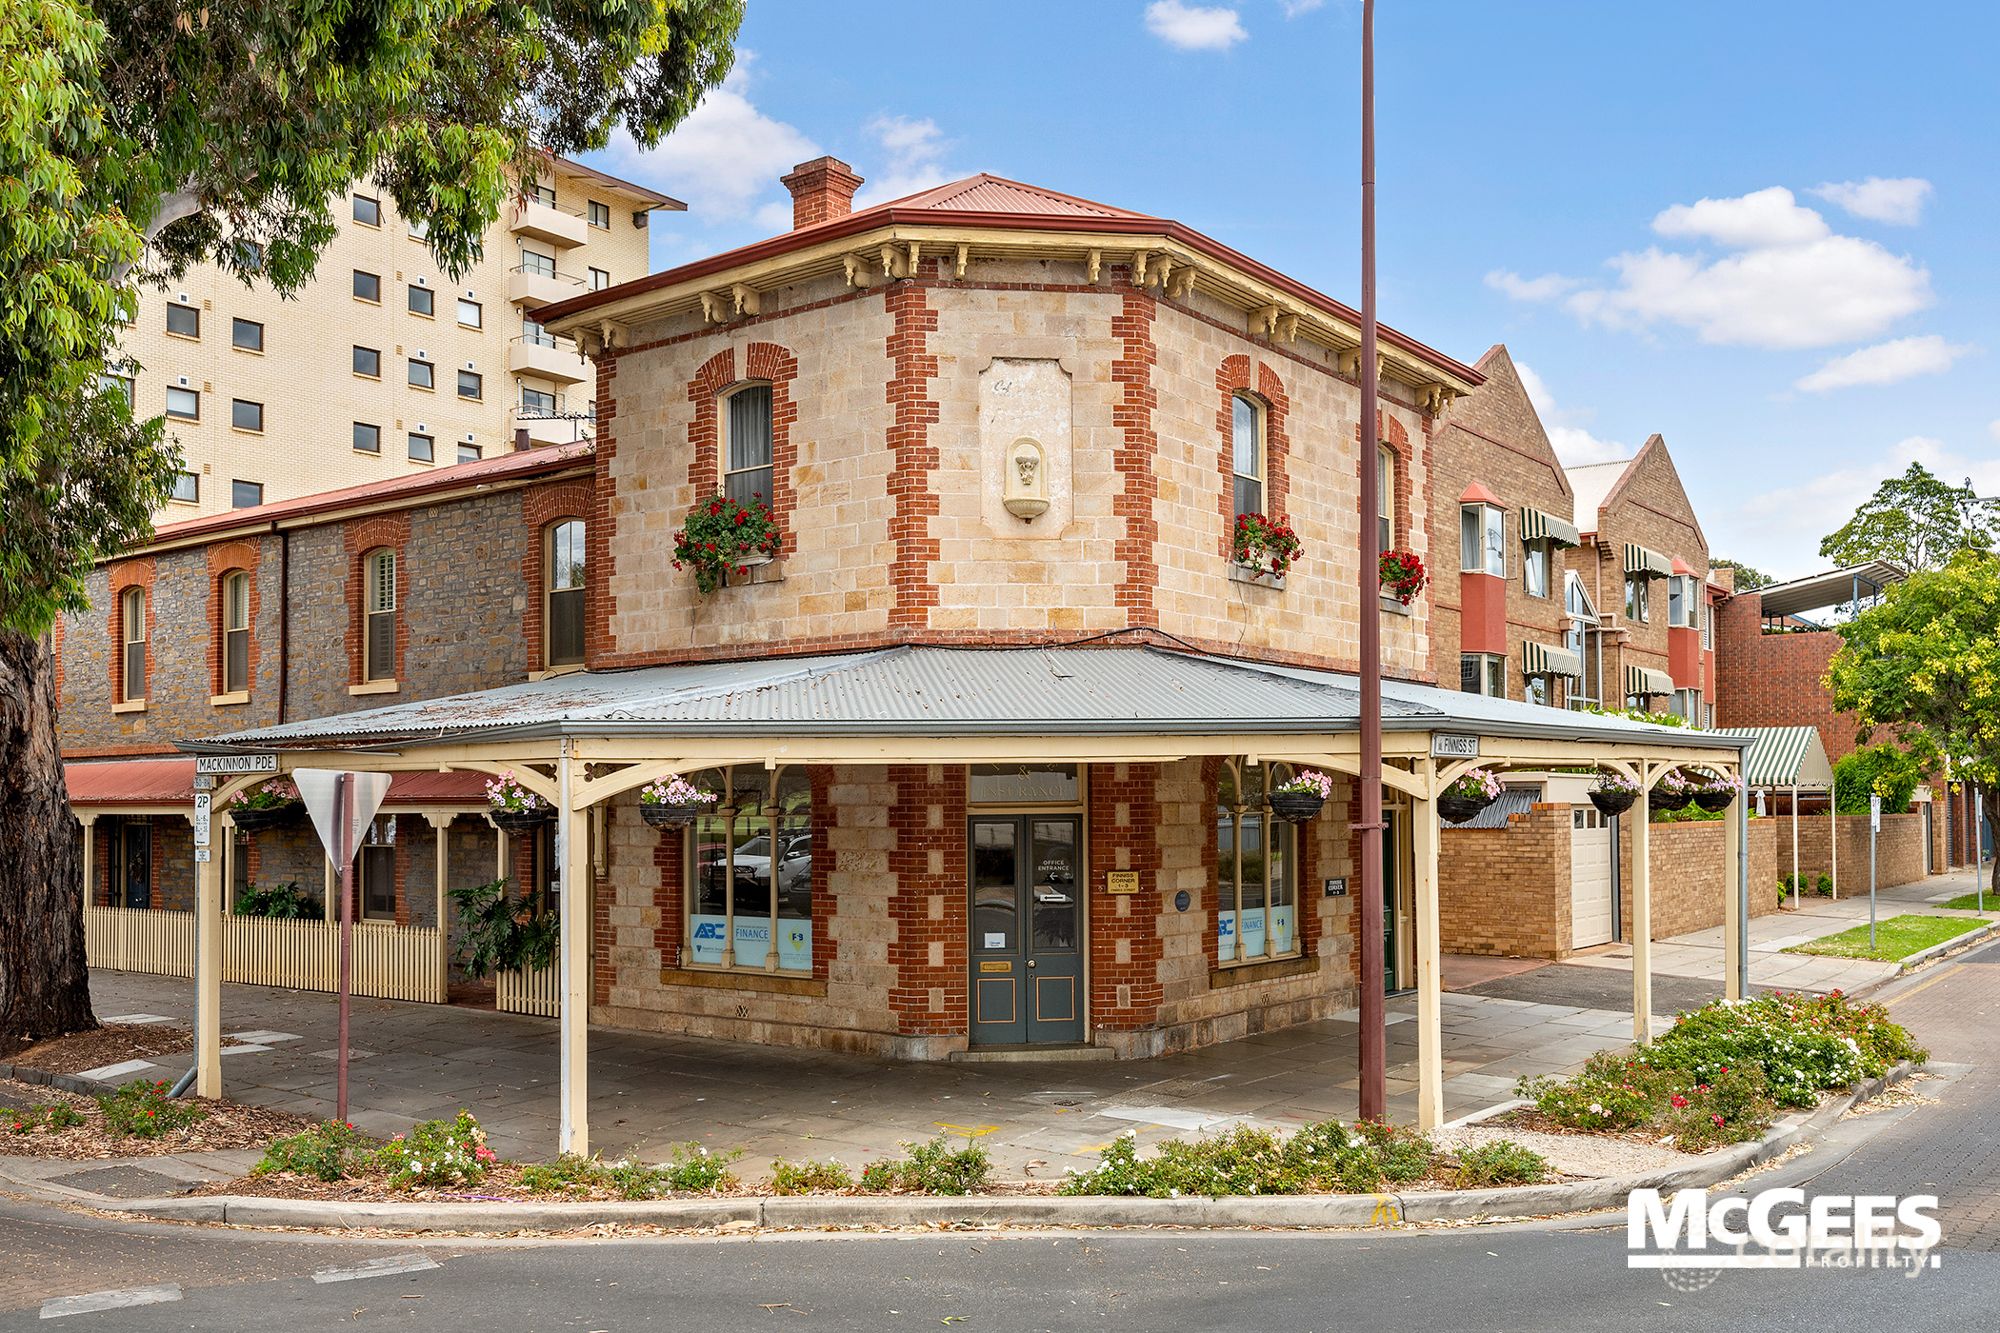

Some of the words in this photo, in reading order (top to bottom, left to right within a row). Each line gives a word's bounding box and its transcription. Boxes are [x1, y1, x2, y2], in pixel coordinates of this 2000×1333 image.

[1444, 737, 1468, 753] FINNISS
[1468, 739, 1477, 753] ST
[199, 757, 252, 771] MACKINNON
[1017, 764, 1032, 781] &
[197, 795, 209, 808] 2P
[694, 922, 726, 940] ABC
[735, 928, 769, 940] FINANCE
